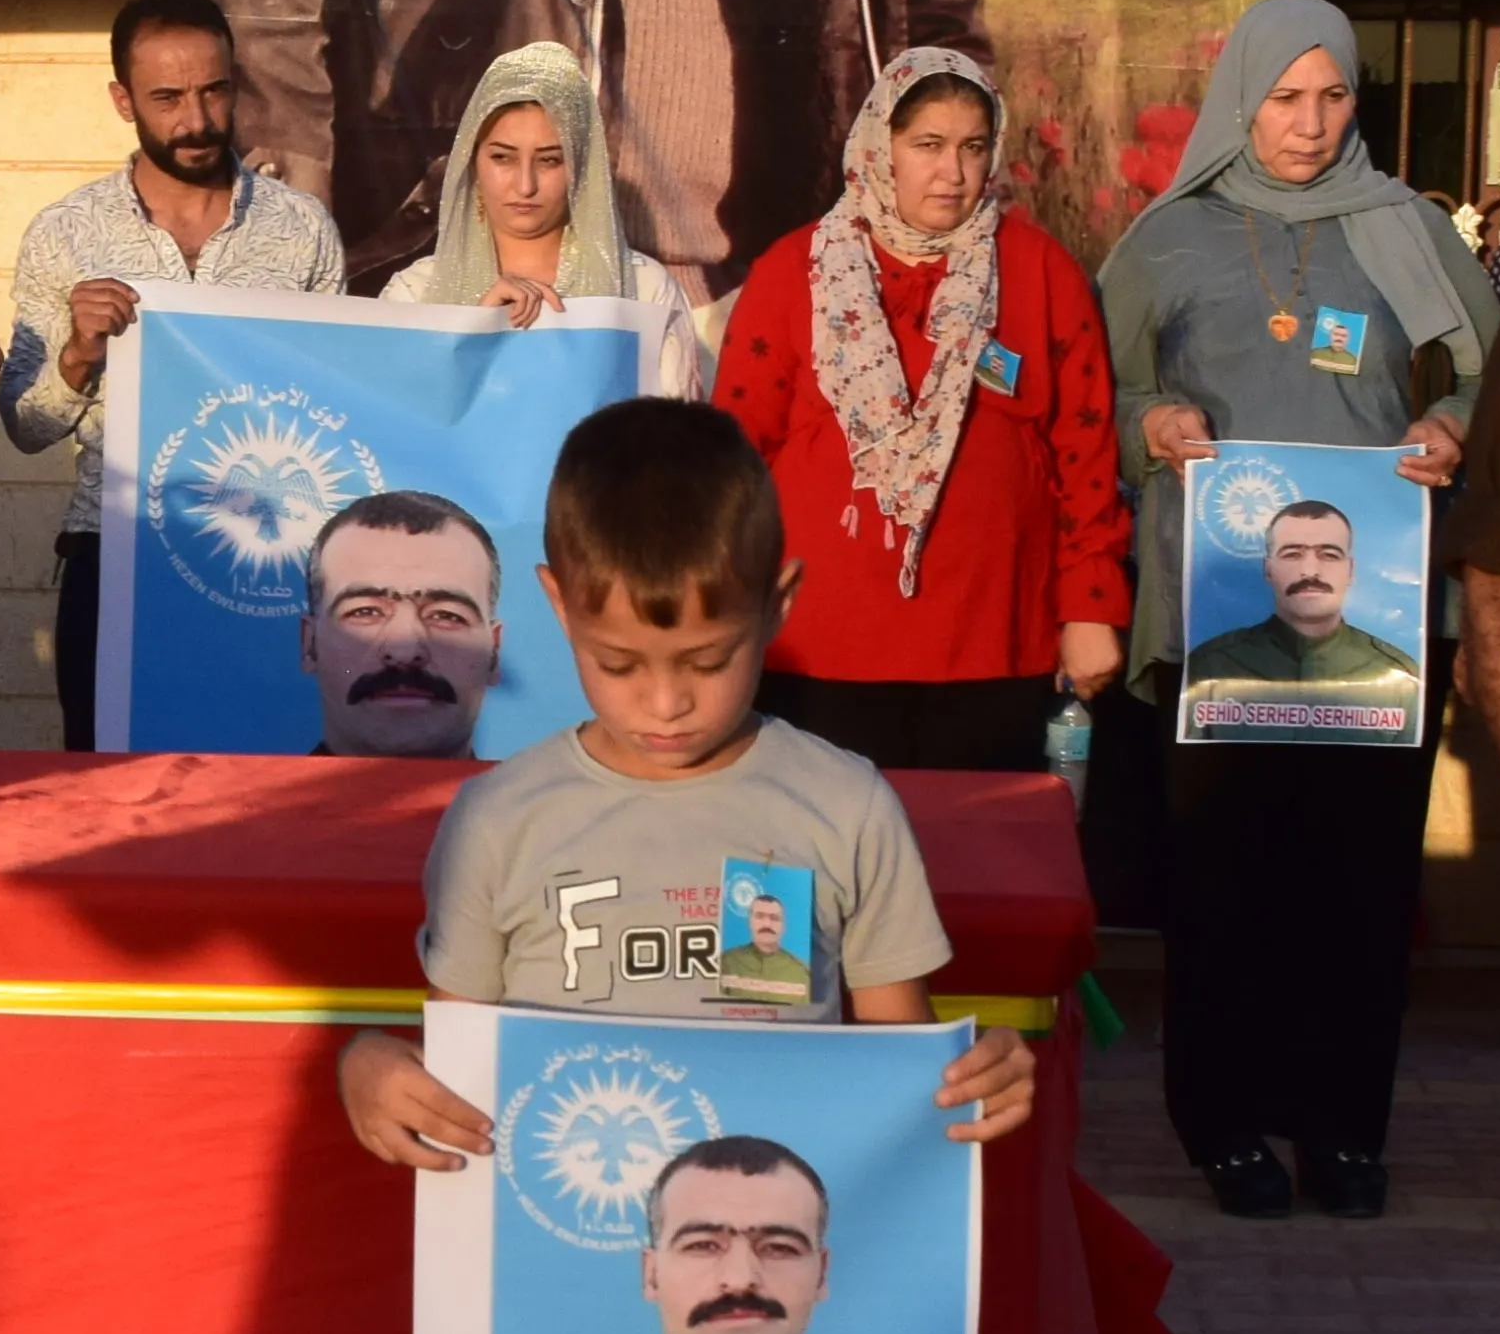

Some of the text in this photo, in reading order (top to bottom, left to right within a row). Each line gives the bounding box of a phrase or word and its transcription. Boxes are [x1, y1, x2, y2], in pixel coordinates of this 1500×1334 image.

[662, 887, 698, 902] THE
[680, 903, 719, 918] HAC
[556, 876, 719, 992] FOR
